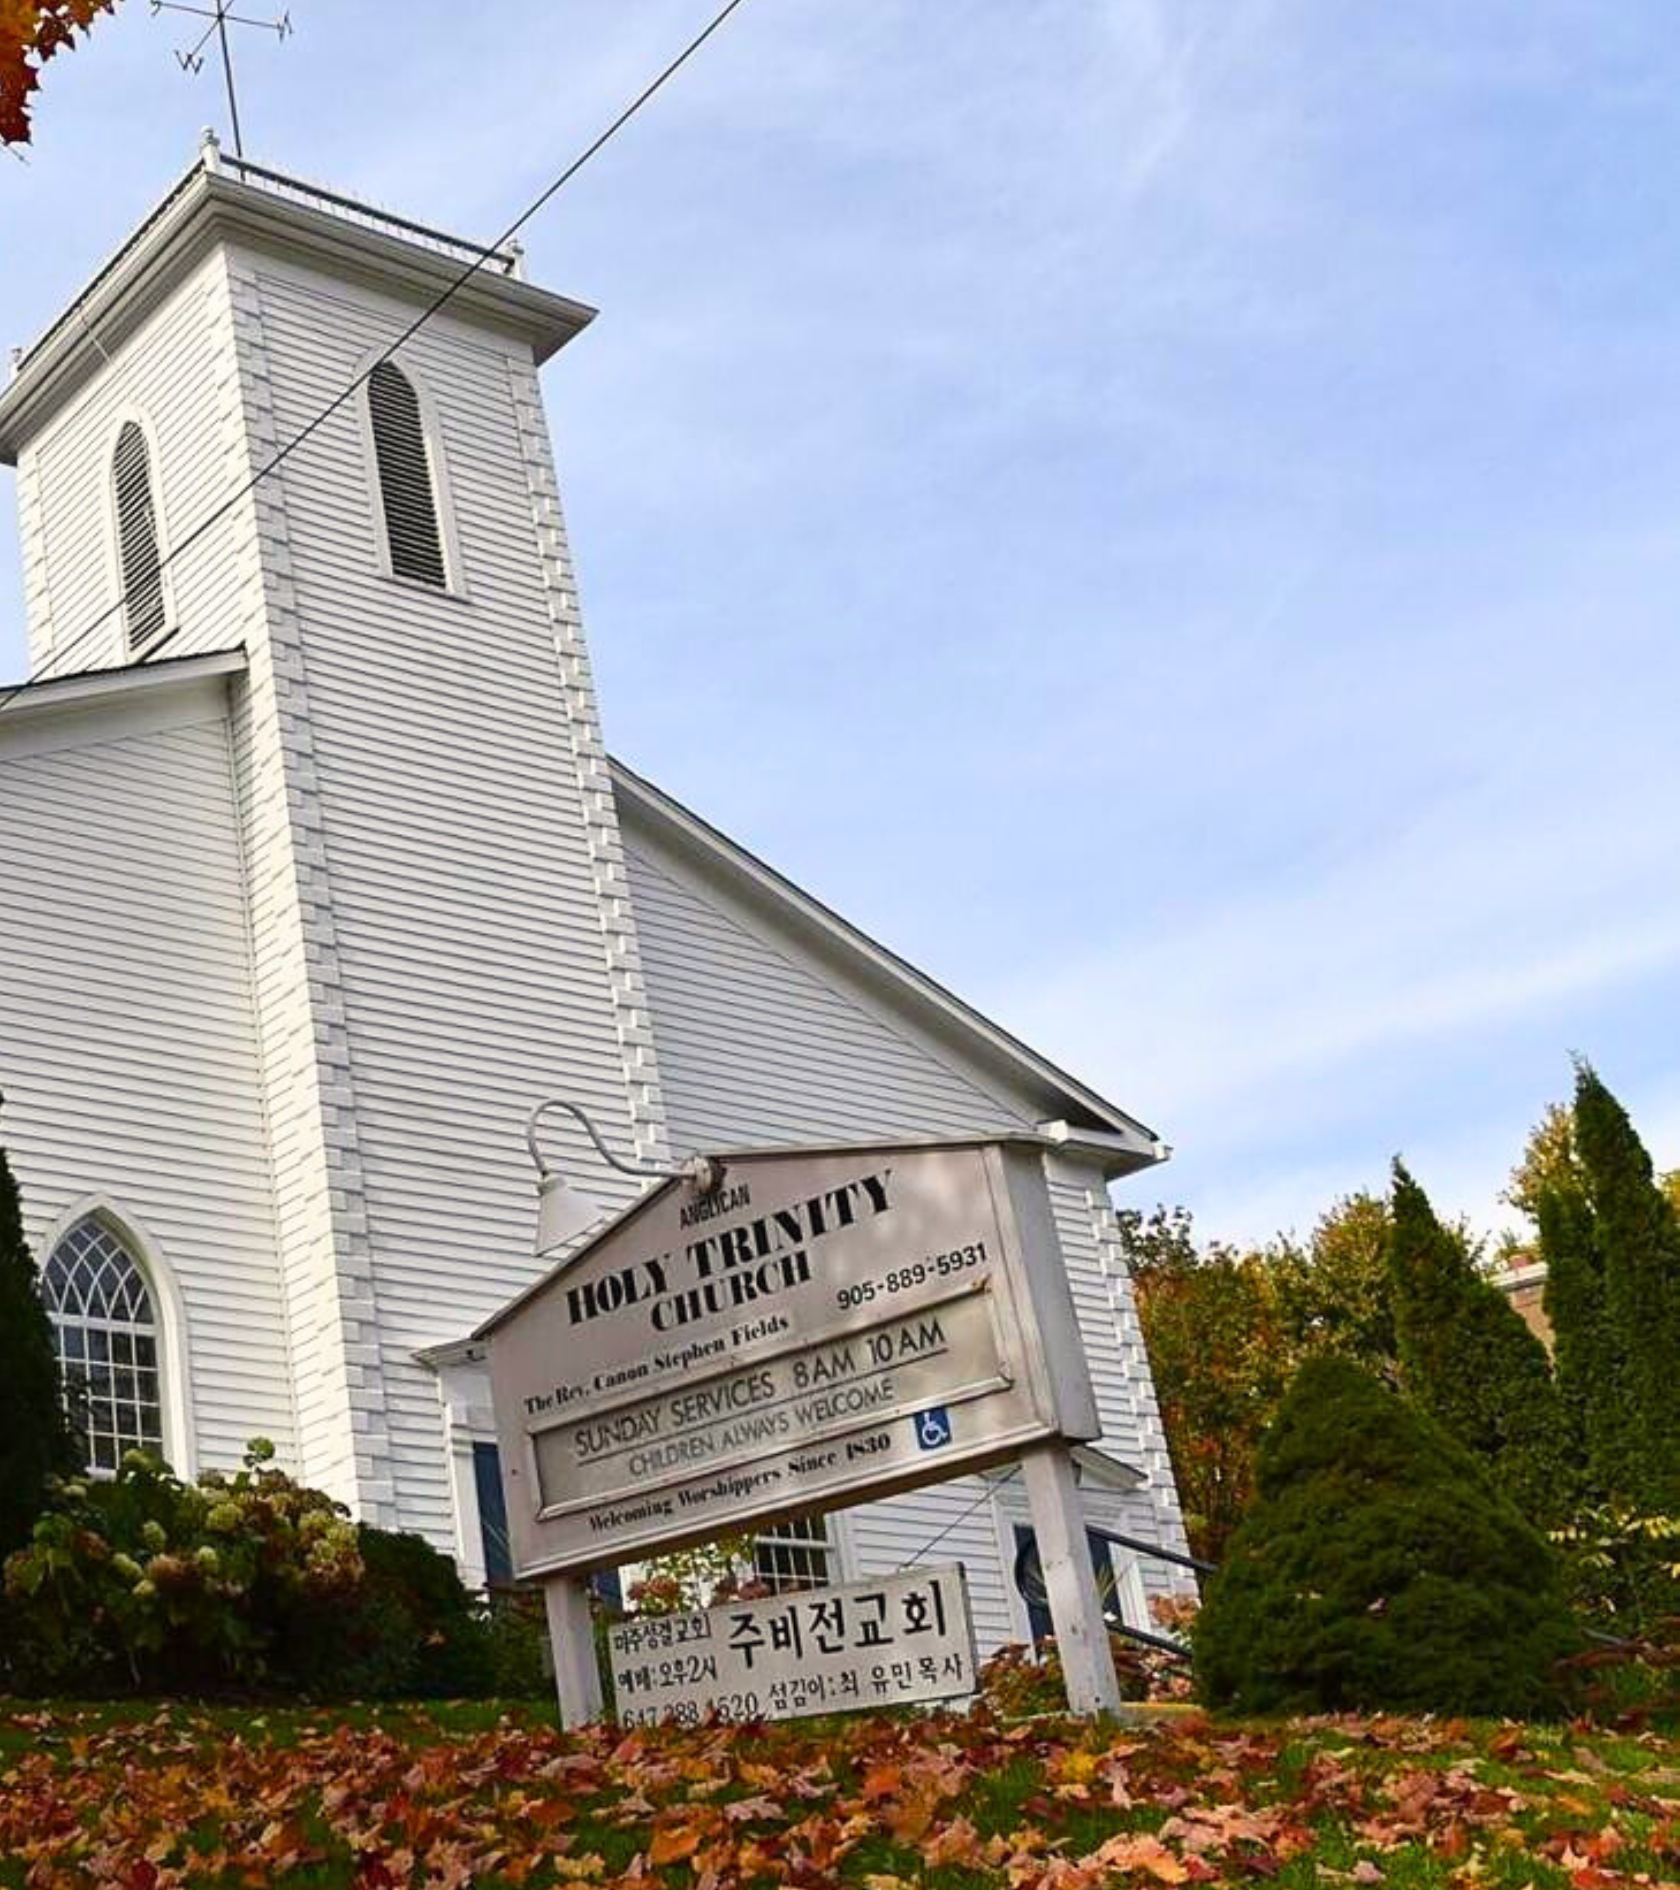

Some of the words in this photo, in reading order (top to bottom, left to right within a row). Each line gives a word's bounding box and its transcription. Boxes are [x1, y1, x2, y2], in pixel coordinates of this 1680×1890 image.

[566, 1254, 670, 1325] HOLY
[687, 1170, 893, 1279] TRINITY
[680, 1183, 750, 1230] ANGLICAN
[651, 1251, 811, 1331] CHURCH
[837, 1242, 987, 1309] 905-889-5931
[524, 1397, 553, 1415] The
[593, 1364, 649, 1391] Canon
[655, 1337, 726, 1371] Stephen
[731, 1315, 789, 1347] Fields
[575, 1408, 661, 1457] SUNDAY
[670, 1372, 775, 1427] SERVICES
[629, 1437, 714, 1477] CHILDREN
[722, 1412, 789, 1449] ALWAYS
[795, 1378, 895, 1423] WELCOME
[589, 1498, 673, 1532] Welcoming
[678, 1468, 782, 1508] Worshippers
[787, 1449, 838, 1477] Since
[845, 1432, 891, 1463] 1830
[728, 1579, 946, 1668] 주비전교회
